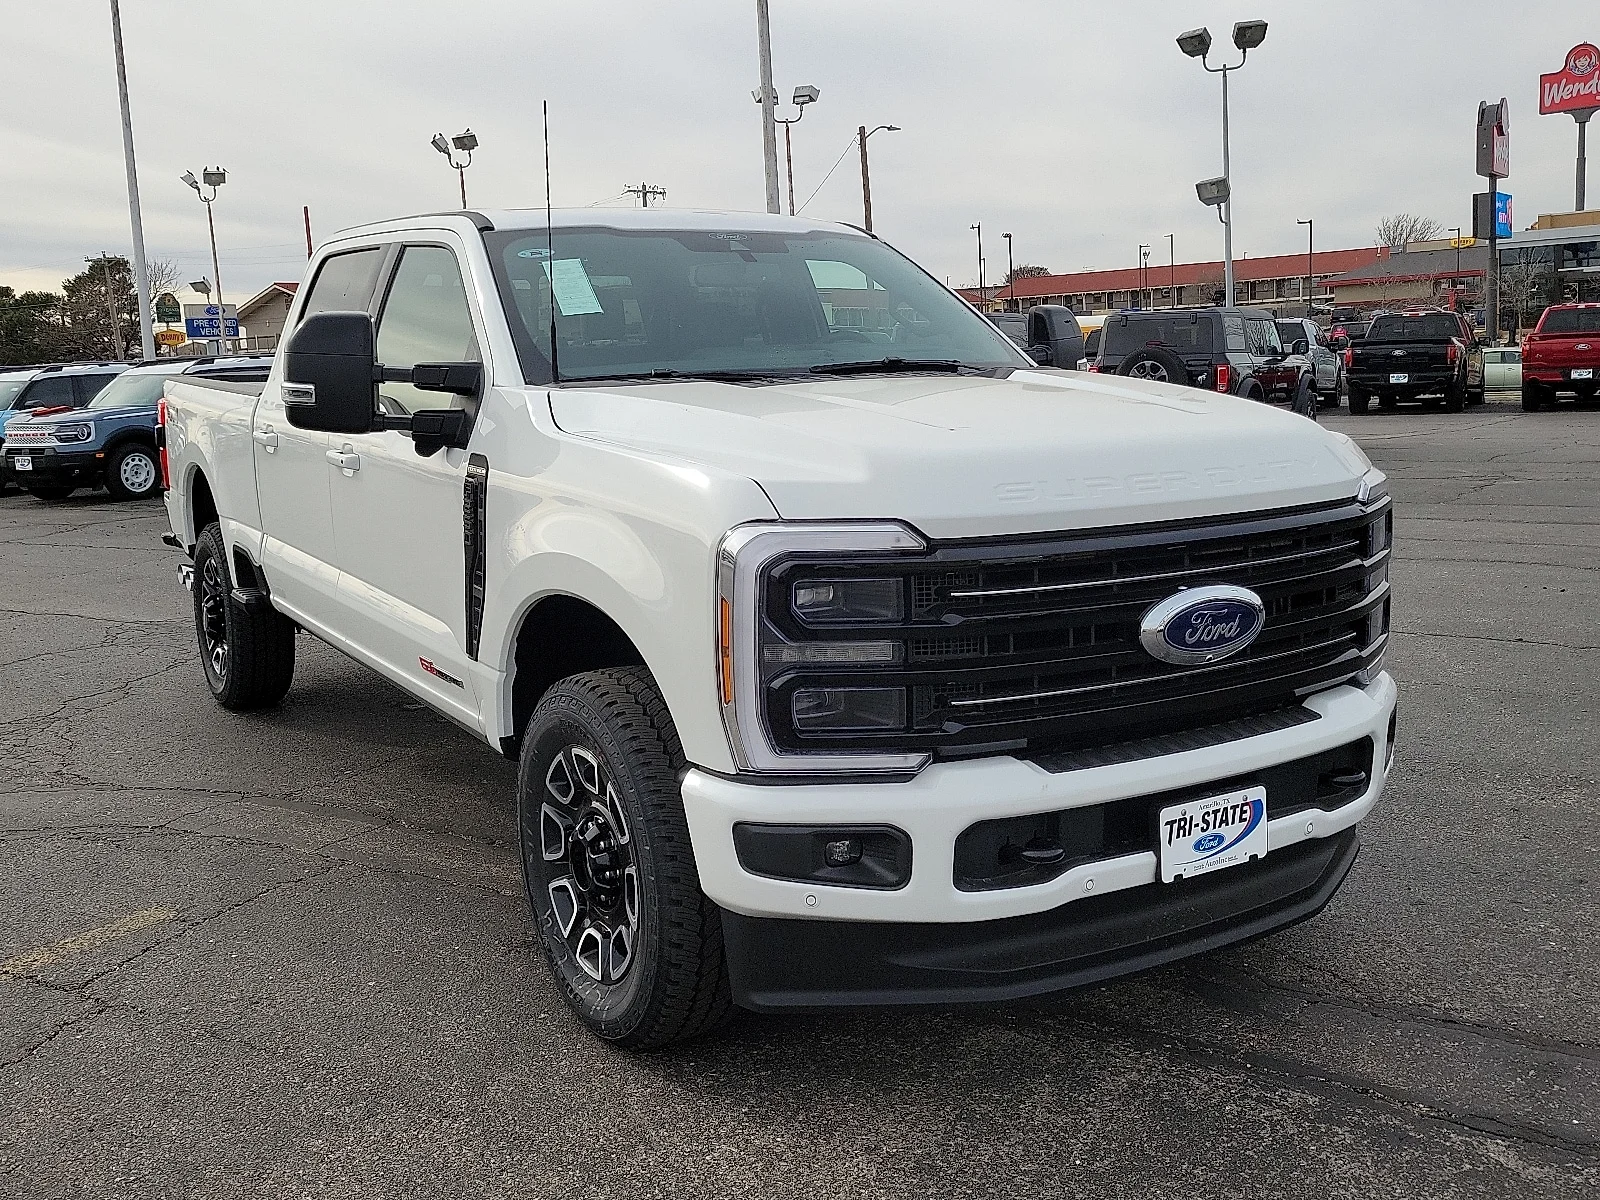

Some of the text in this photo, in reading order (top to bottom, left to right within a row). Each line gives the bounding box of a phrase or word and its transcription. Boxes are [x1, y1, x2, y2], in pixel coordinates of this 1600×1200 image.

[1544, 70, 1600, 107] Wend
[200, 328, 234, 336] VEHICES
[993, 470, 1201, 504] SUPER
[1185, 608, 1242, 645] Ford
[1164, 802, 1250, 848] TRI-STATE
[1199, 836, 1219, 851] Ford
